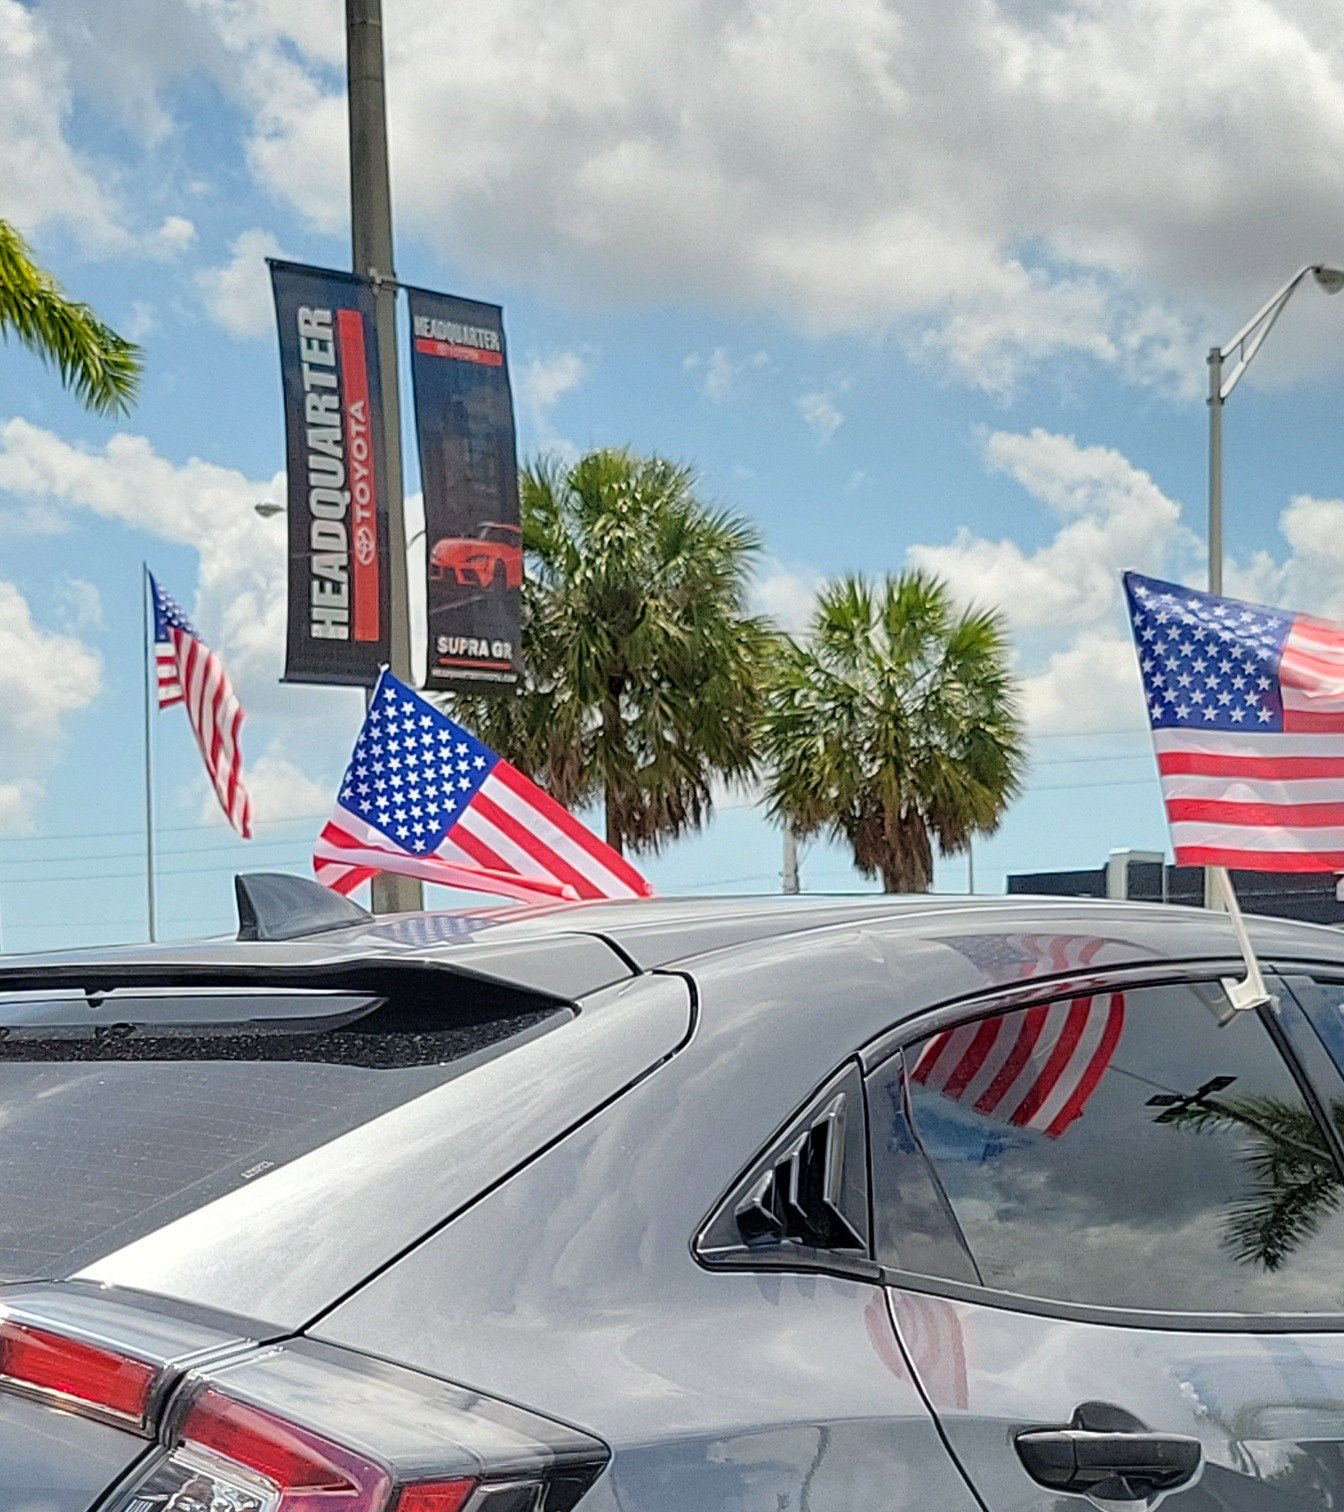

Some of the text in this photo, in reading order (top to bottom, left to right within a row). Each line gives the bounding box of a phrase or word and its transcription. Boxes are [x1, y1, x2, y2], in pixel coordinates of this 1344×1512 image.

[298, 306, 351, 641] HEADQUARTER
[348, 400, 372, 523] TOYOTA
[437, 635, 514, 660] SUPRA GR
